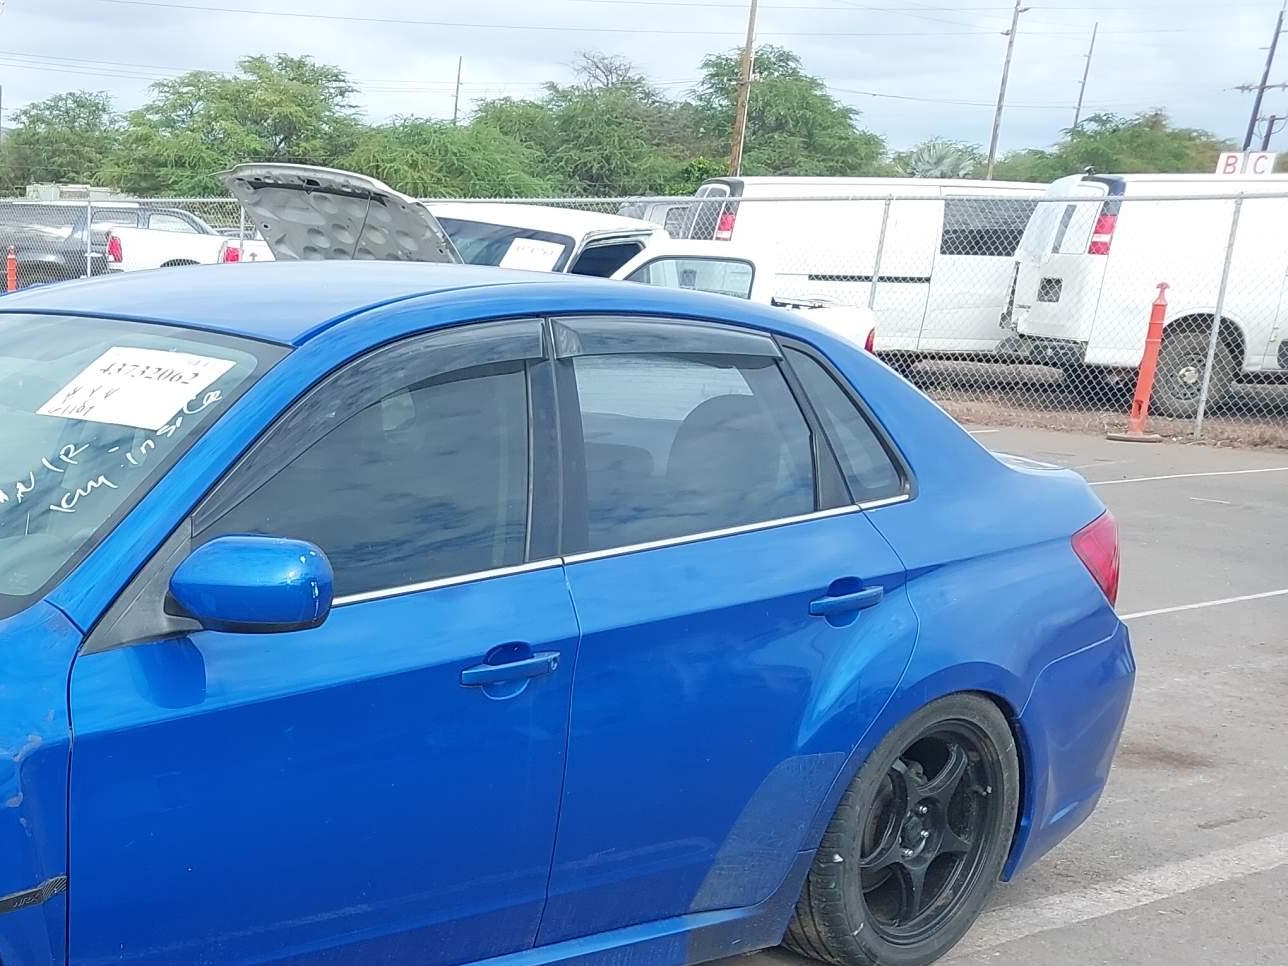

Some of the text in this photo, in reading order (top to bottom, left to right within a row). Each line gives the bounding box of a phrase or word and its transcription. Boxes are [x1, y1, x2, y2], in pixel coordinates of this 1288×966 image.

[1223, 155, 1269, 175] B C
[100, 362, 201, 384] 43732062
